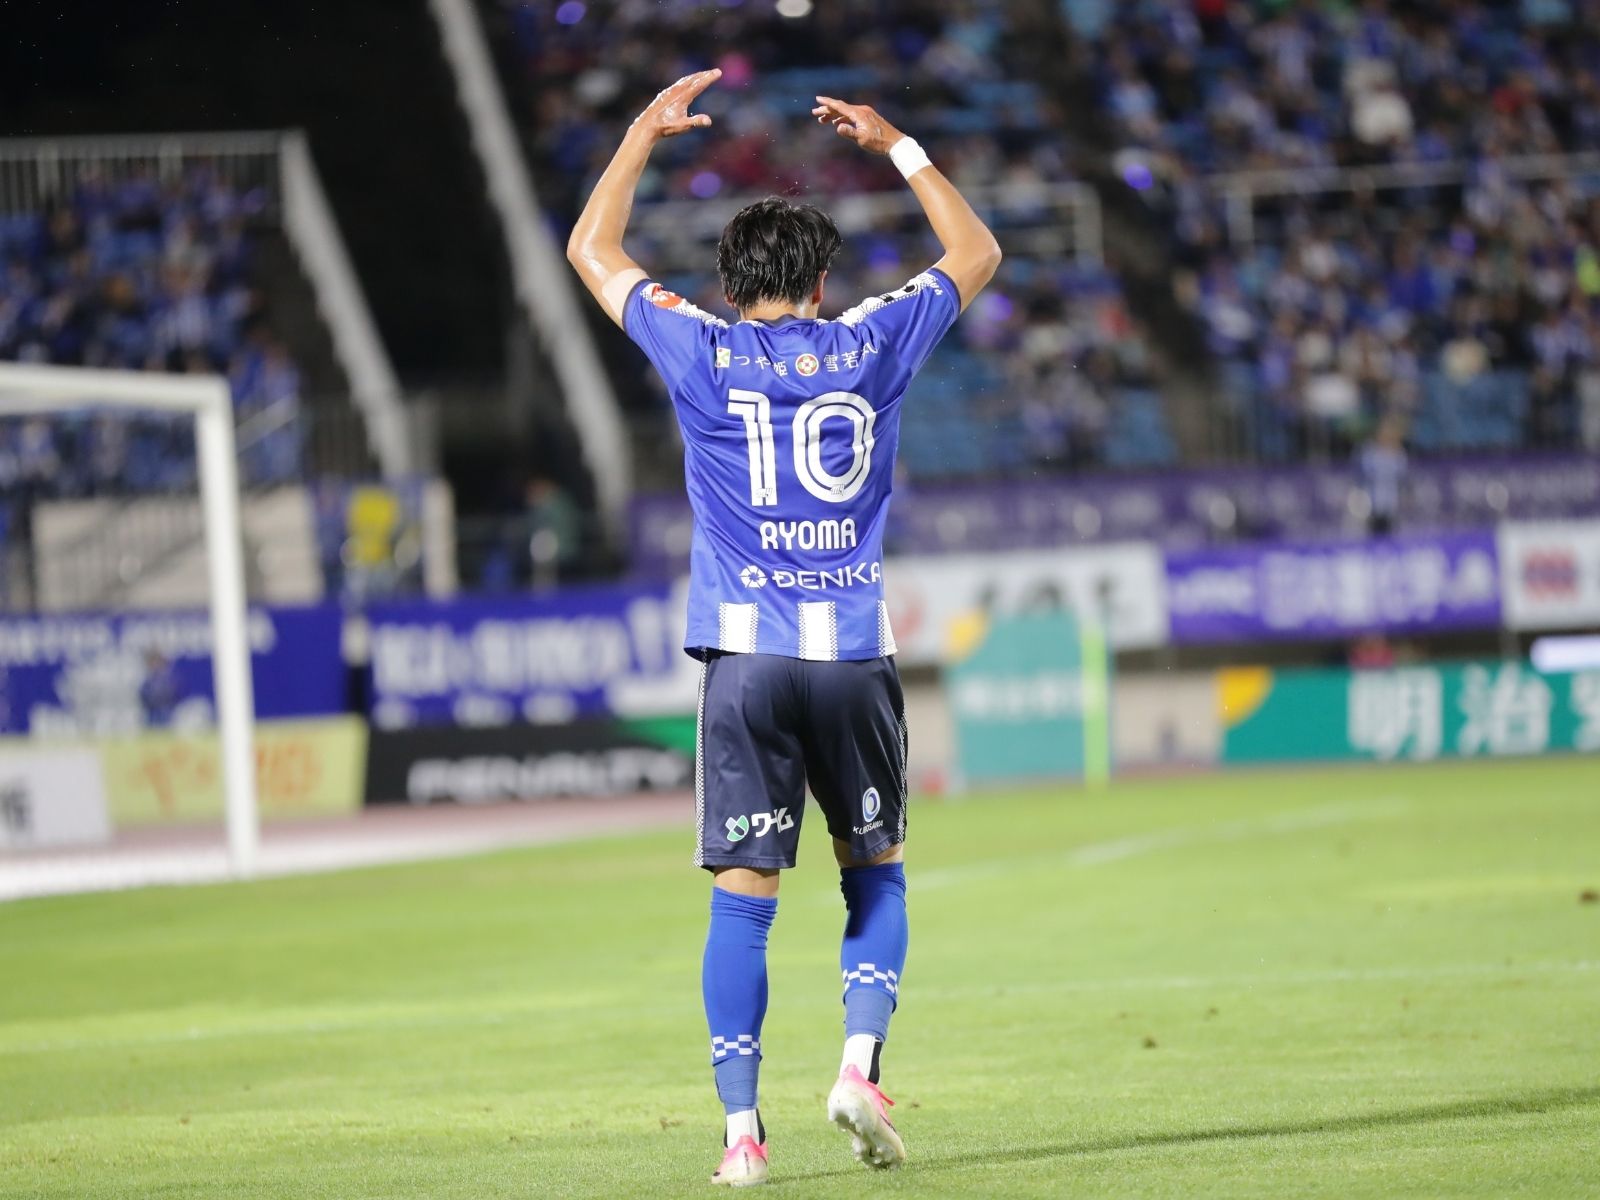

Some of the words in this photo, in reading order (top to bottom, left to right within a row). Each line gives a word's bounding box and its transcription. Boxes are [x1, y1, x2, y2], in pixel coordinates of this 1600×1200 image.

[734, 355, 788, 376] つや姫
[728, 388, 876, 506] 10
[760, 518, 856, 550] RYOMA
[772, 561, 881, 590] DENKA
